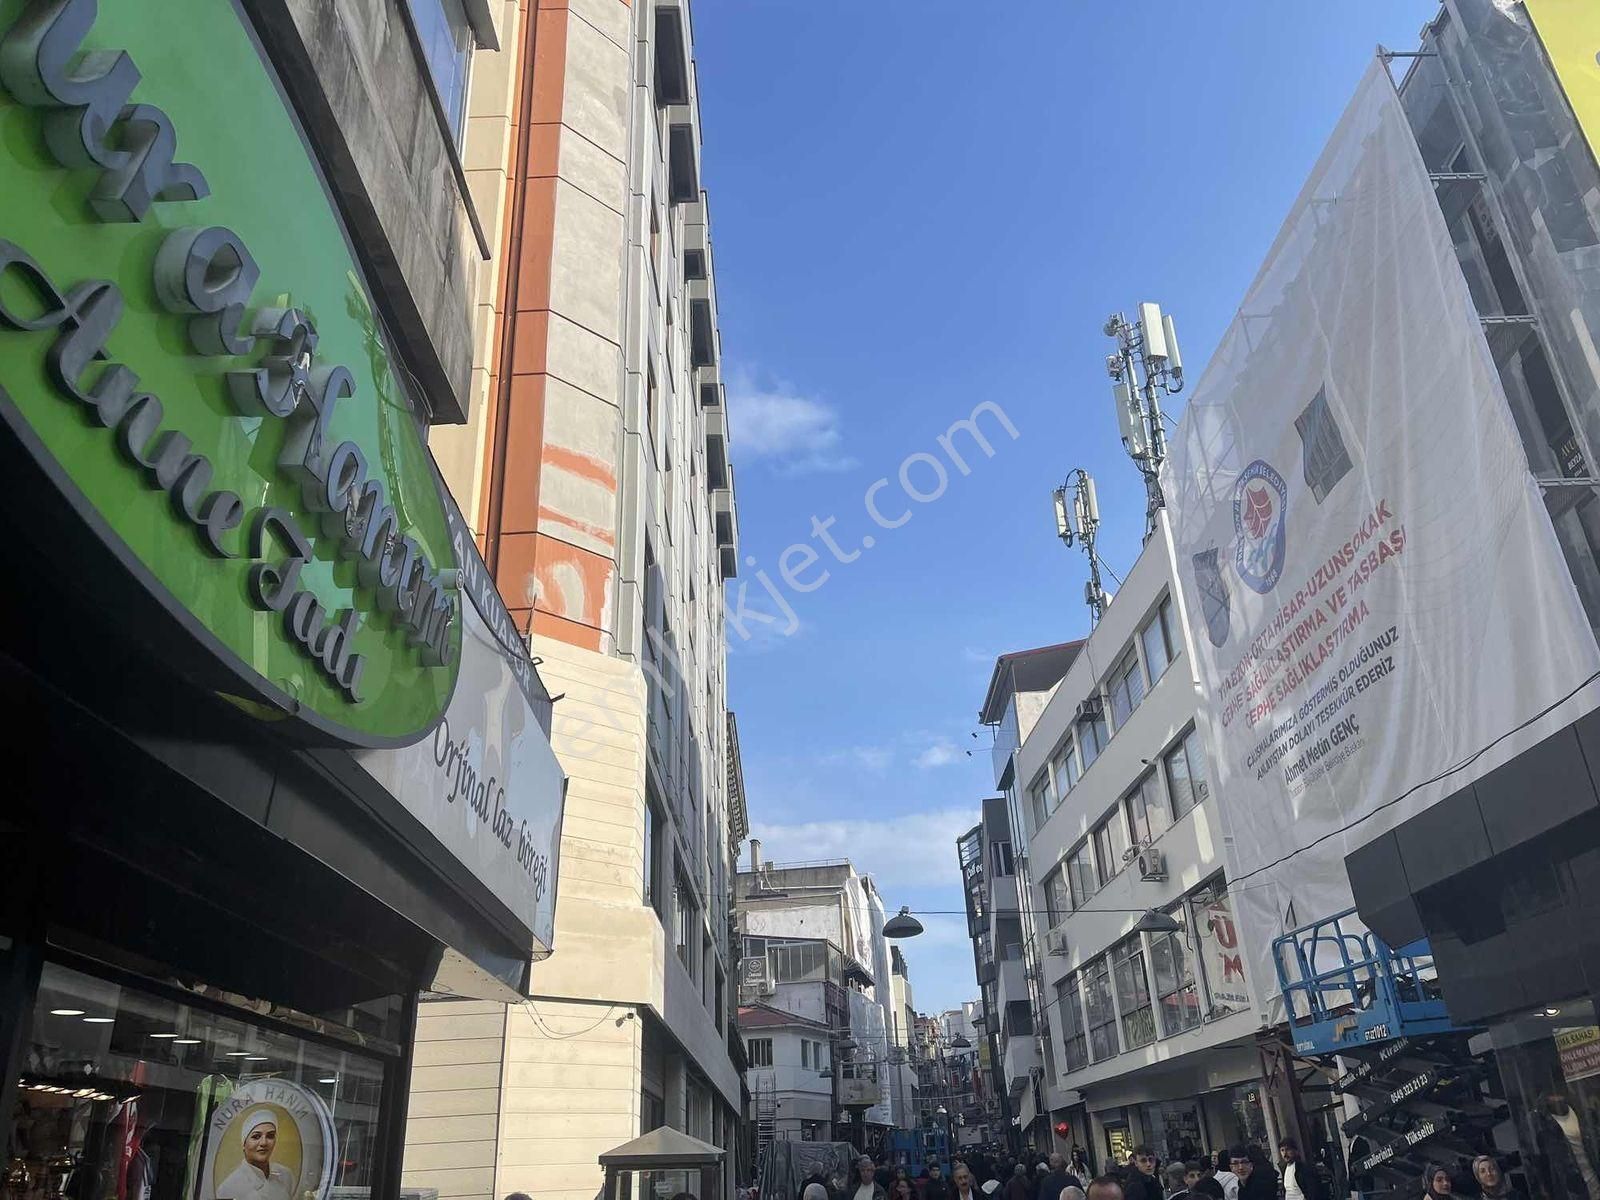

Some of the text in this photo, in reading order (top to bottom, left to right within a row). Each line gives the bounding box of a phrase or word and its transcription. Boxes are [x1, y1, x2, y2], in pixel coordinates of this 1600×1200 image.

[2, 0, 455, 667] ura Hanım
[0, 238, 366, 703] Anne Tadı
[1326, 586, 1348, 615] VE
[1347, 525, 1406, 595] TAŞBAŞI
[1245, 599, 1370, 729] CEPHE SAĞLIKLAŞTIRMA
[1289, 722, 1315, 751] DOLAYI
[1315, 687, 1357, 727] TEŞEKKÜR
[1357, 655, 1396, 694] EDERİZ
[1299, 674, 1339, 721] GÖSTERMİŞ
[1339, 625, 1399, 683] OLDUĞUNUZ
[1285, 754, 1310, 785] Ahmet
[1307, 737, 1330, 764] Metin
[1330, 713, 1361, 746] GENÇ
[434, 720, 496, 823] Orjinal
[517, 821, 548, 902] böreği
[1378, 1036, 1409, 1061] Kiralık
[1390, 1072, 1428, 1104] 0549 323 21 23
[214, 1092, 255, 1130] NURA
[1405, 1121, 1435, 1146] Yükseltir
